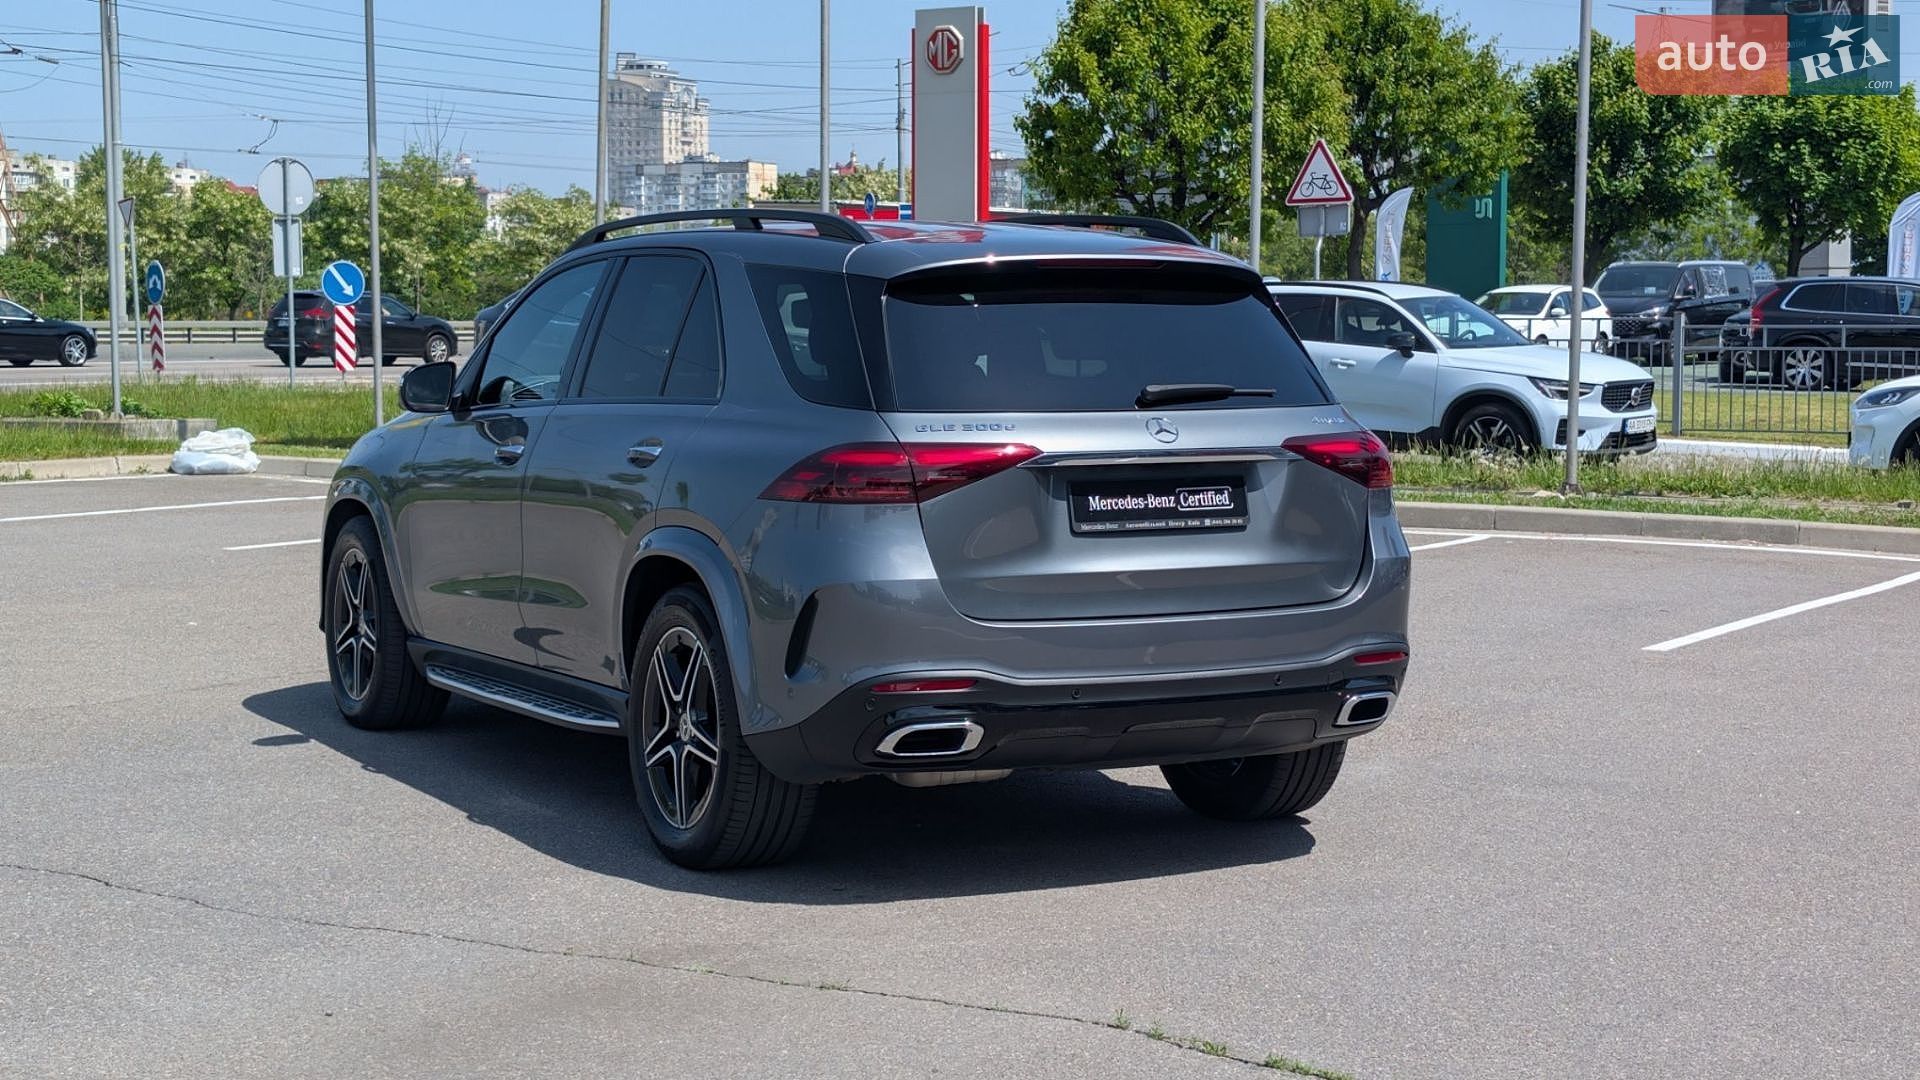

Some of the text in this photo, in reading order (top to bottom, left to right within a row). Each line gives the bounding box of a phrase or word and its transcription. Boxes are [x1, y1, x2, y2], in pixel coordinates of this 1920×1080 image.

[927, 29, 960, 71] MG
[914, 423, 957, 433] GLE
[1088, 490, 1231, 511] Mercedes-Benz Certified
